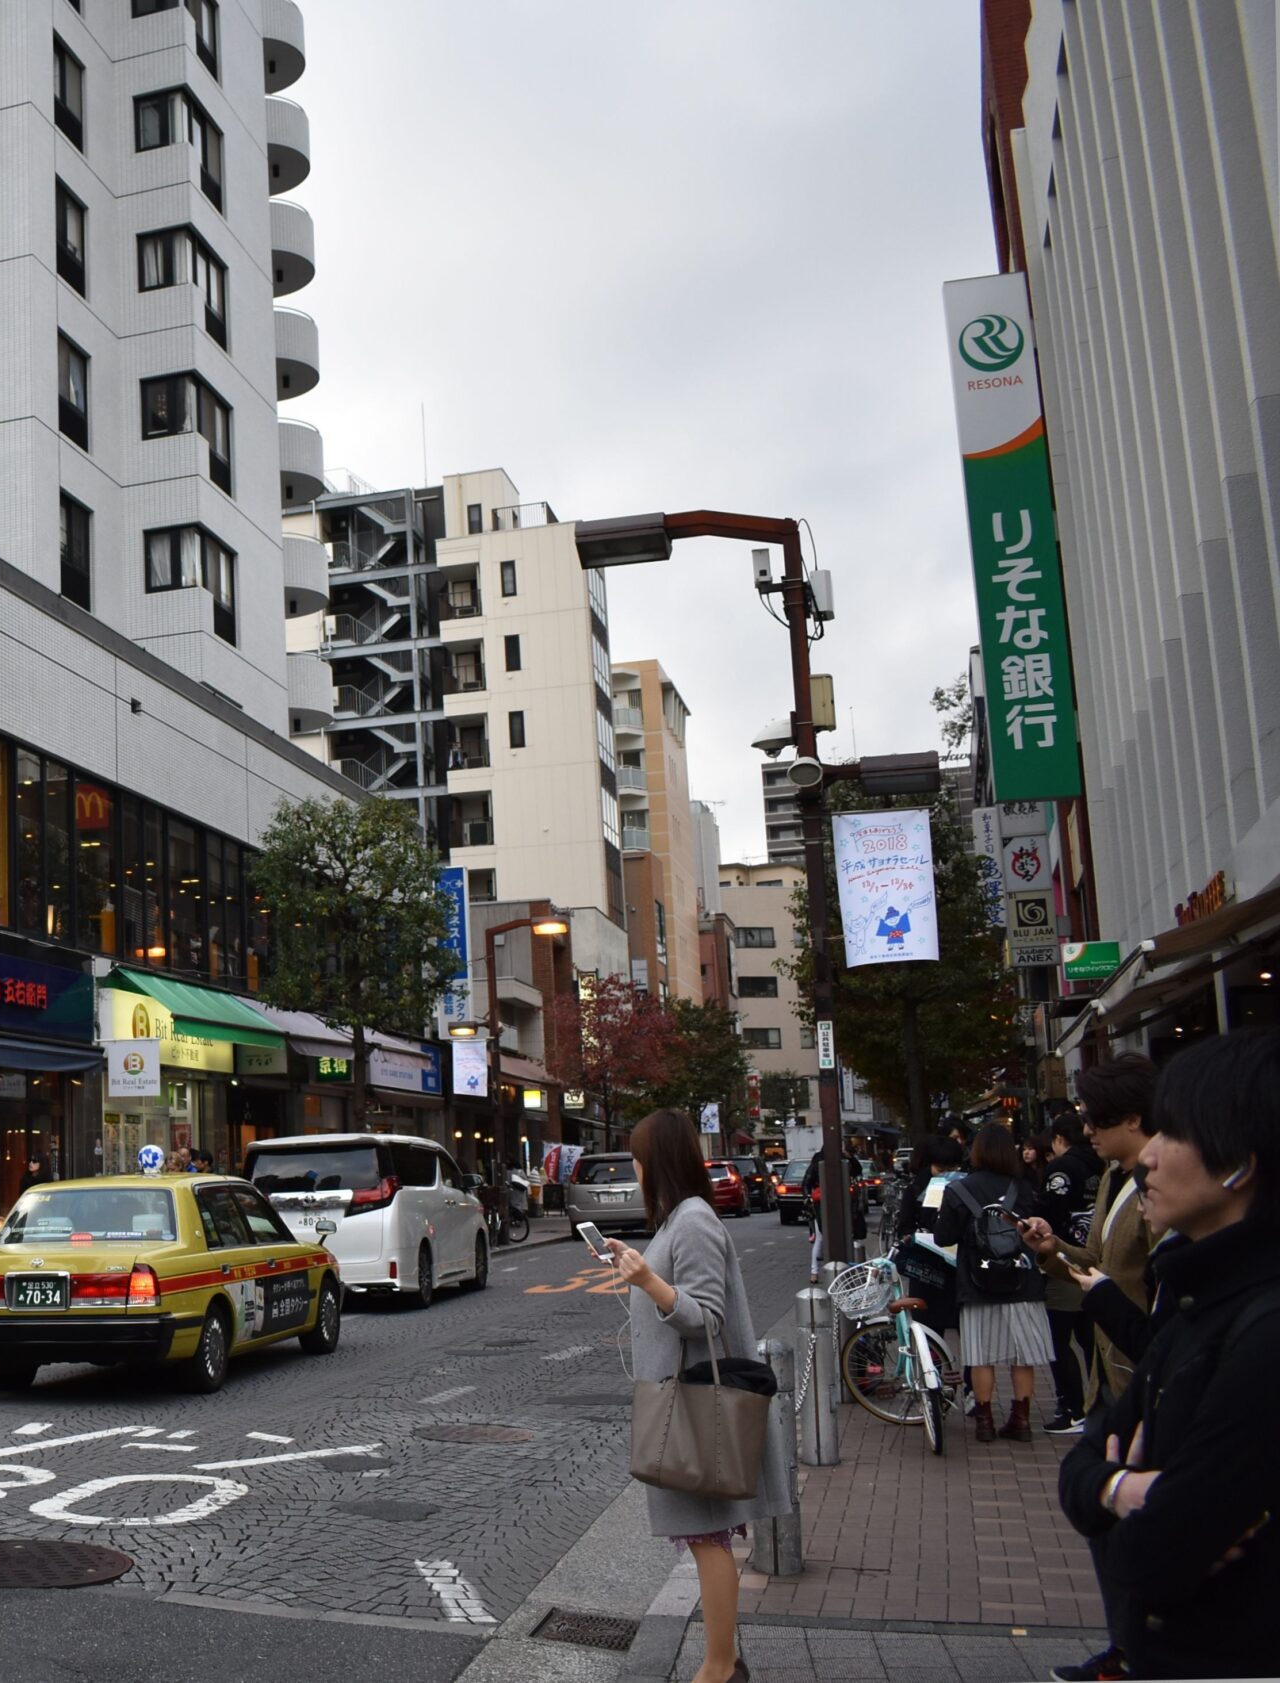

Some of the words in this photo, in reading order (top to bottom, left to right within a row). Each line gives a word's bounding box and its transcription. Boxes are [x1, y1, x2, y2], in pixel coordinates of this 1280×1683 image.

[967, 375, 1024, 392] RESONA
[991, 508, 1057, 750] りそな銀行
[862, 833, 908, 855] 2018
[1013, 929, 1030, 938] BLU
[1032, 927, 1054, 937] JAM
[1018, 954, 1054, 964] ANEX
[155, 1018, 167, 1040] Bit
[141, 1153, 154, 1165] N
[41, 1281, 54, 1290] 530
[25, 1289, 61, 1305] 70-34
